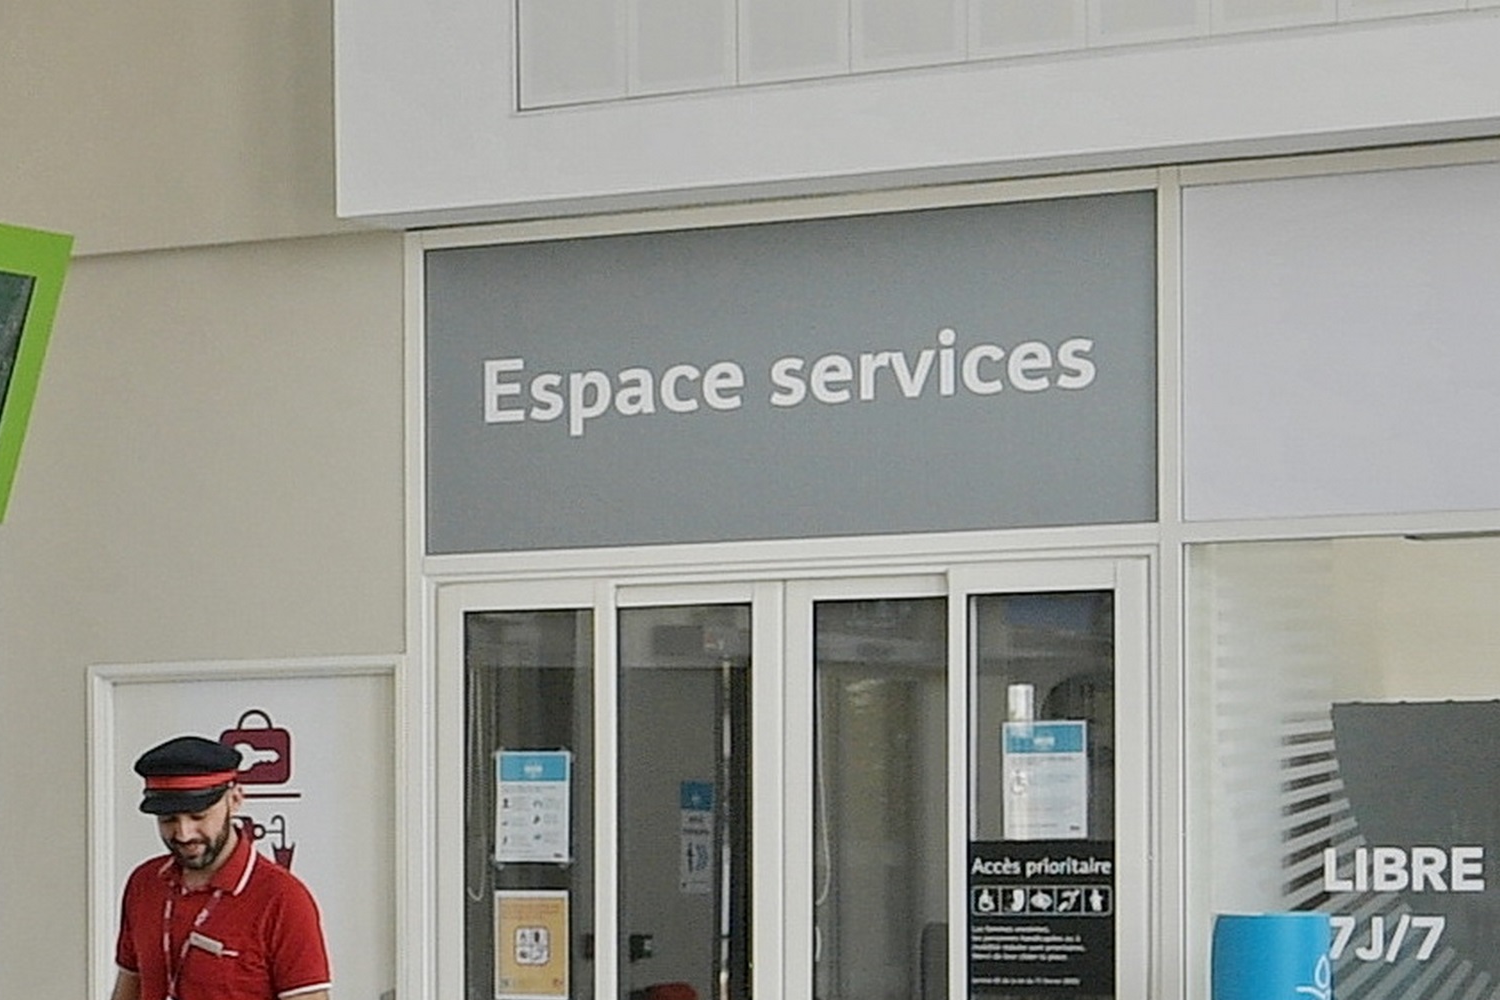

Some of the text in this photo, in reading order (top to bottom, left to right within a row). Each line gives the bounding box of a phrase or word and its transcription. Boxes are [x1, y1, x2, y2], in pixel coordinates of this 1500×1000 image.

[482, 328, 1097, 437] Espace services
[970, 856, 1113, 878] Accès prioritaire
[1323, 847, 1486, 892] LIBRE
[1329, 914, 1446, 963] 7J/7
